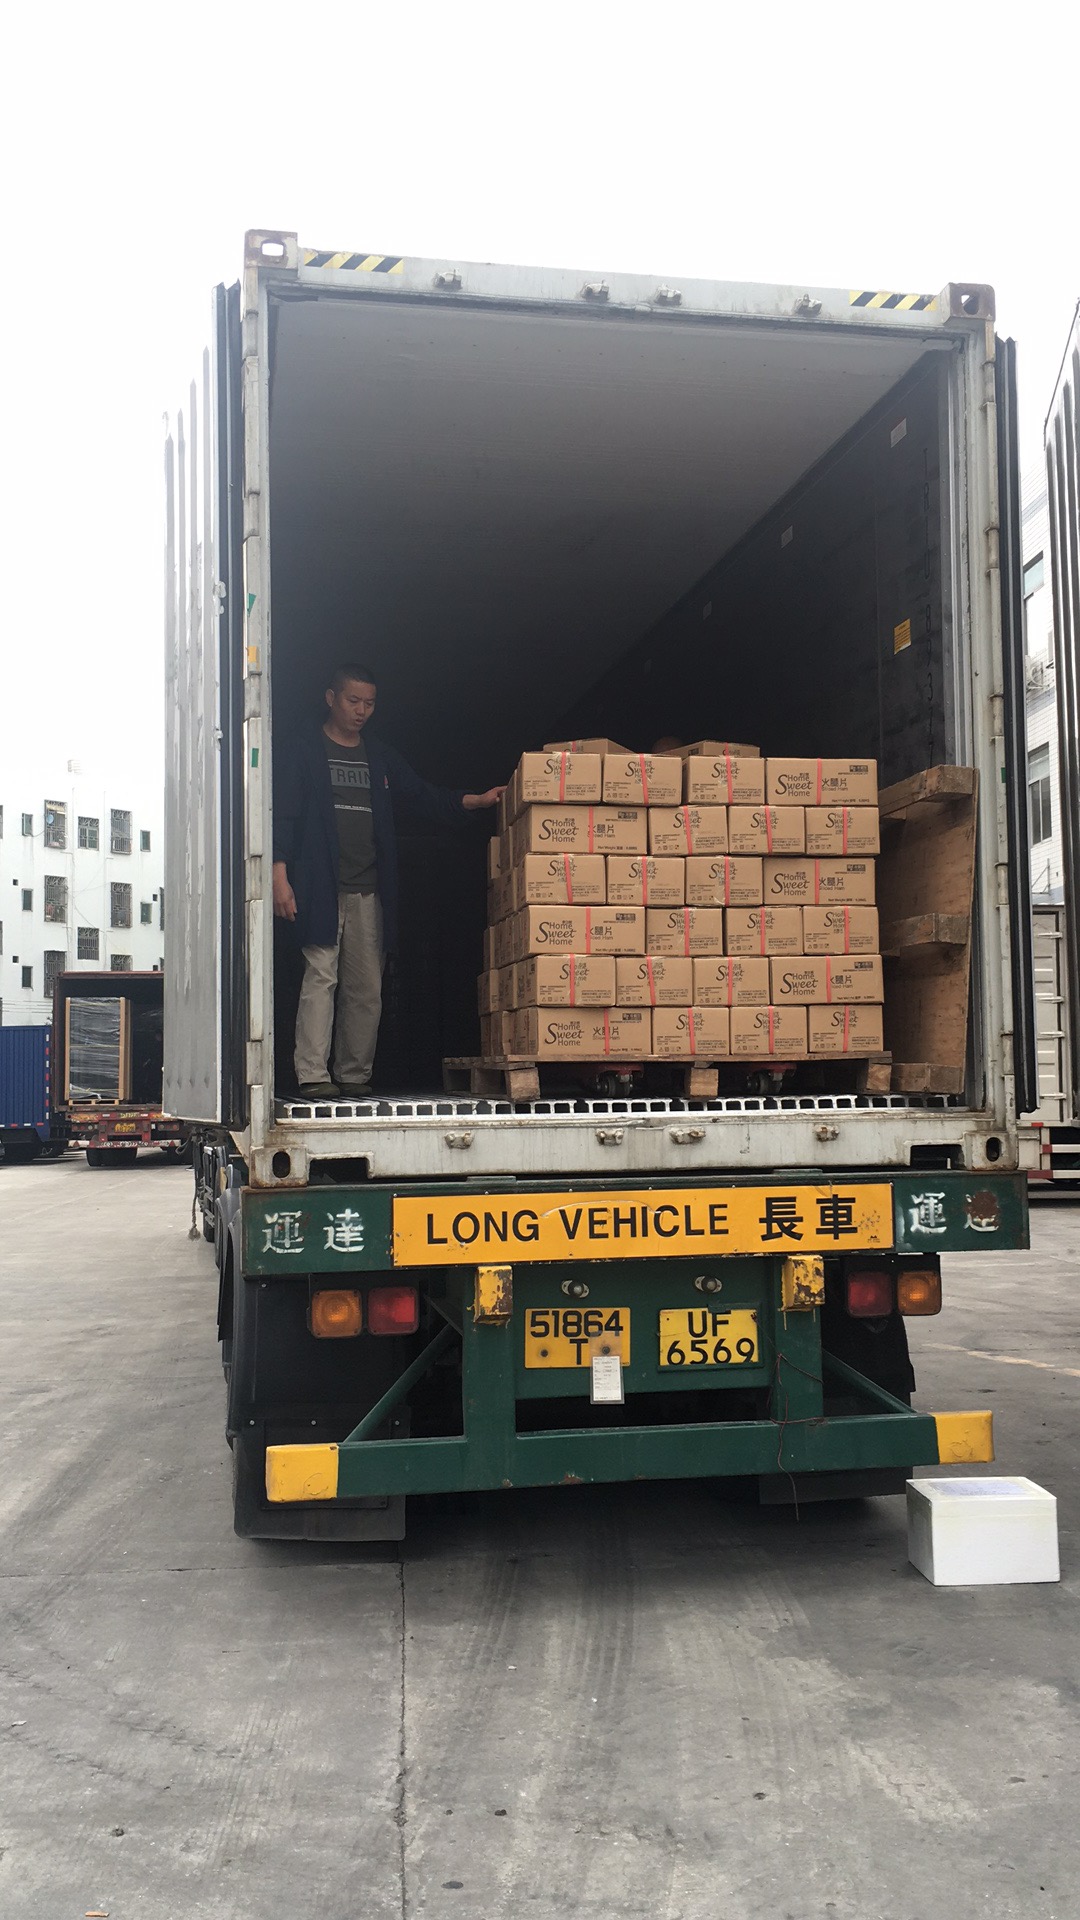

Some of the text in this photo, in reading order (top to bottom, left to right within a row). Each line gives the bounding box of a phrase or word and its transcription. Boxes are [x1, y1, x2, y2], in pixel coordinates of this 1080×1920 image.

[775, 774, 814, 795] Sweet
[539, 819, 579, 840] Sweet
[771, 873, 810, 894] Sweet
[536, 922, 576, 943] Sweet
[780, 973, 818, 994] Sweet
[545, 1023, 584, 1044] Sweet
[262, 1208, 365, 1254] 運達
[426, 1193, 859, 1245] LONG VEHICLE 長車
[530, 1309, 624, 1338] 51864
[687, 1310, 732, 1338] UF
[569, 1338, 589, 1366] T
[667, 1337, 755, 1366] 6569
